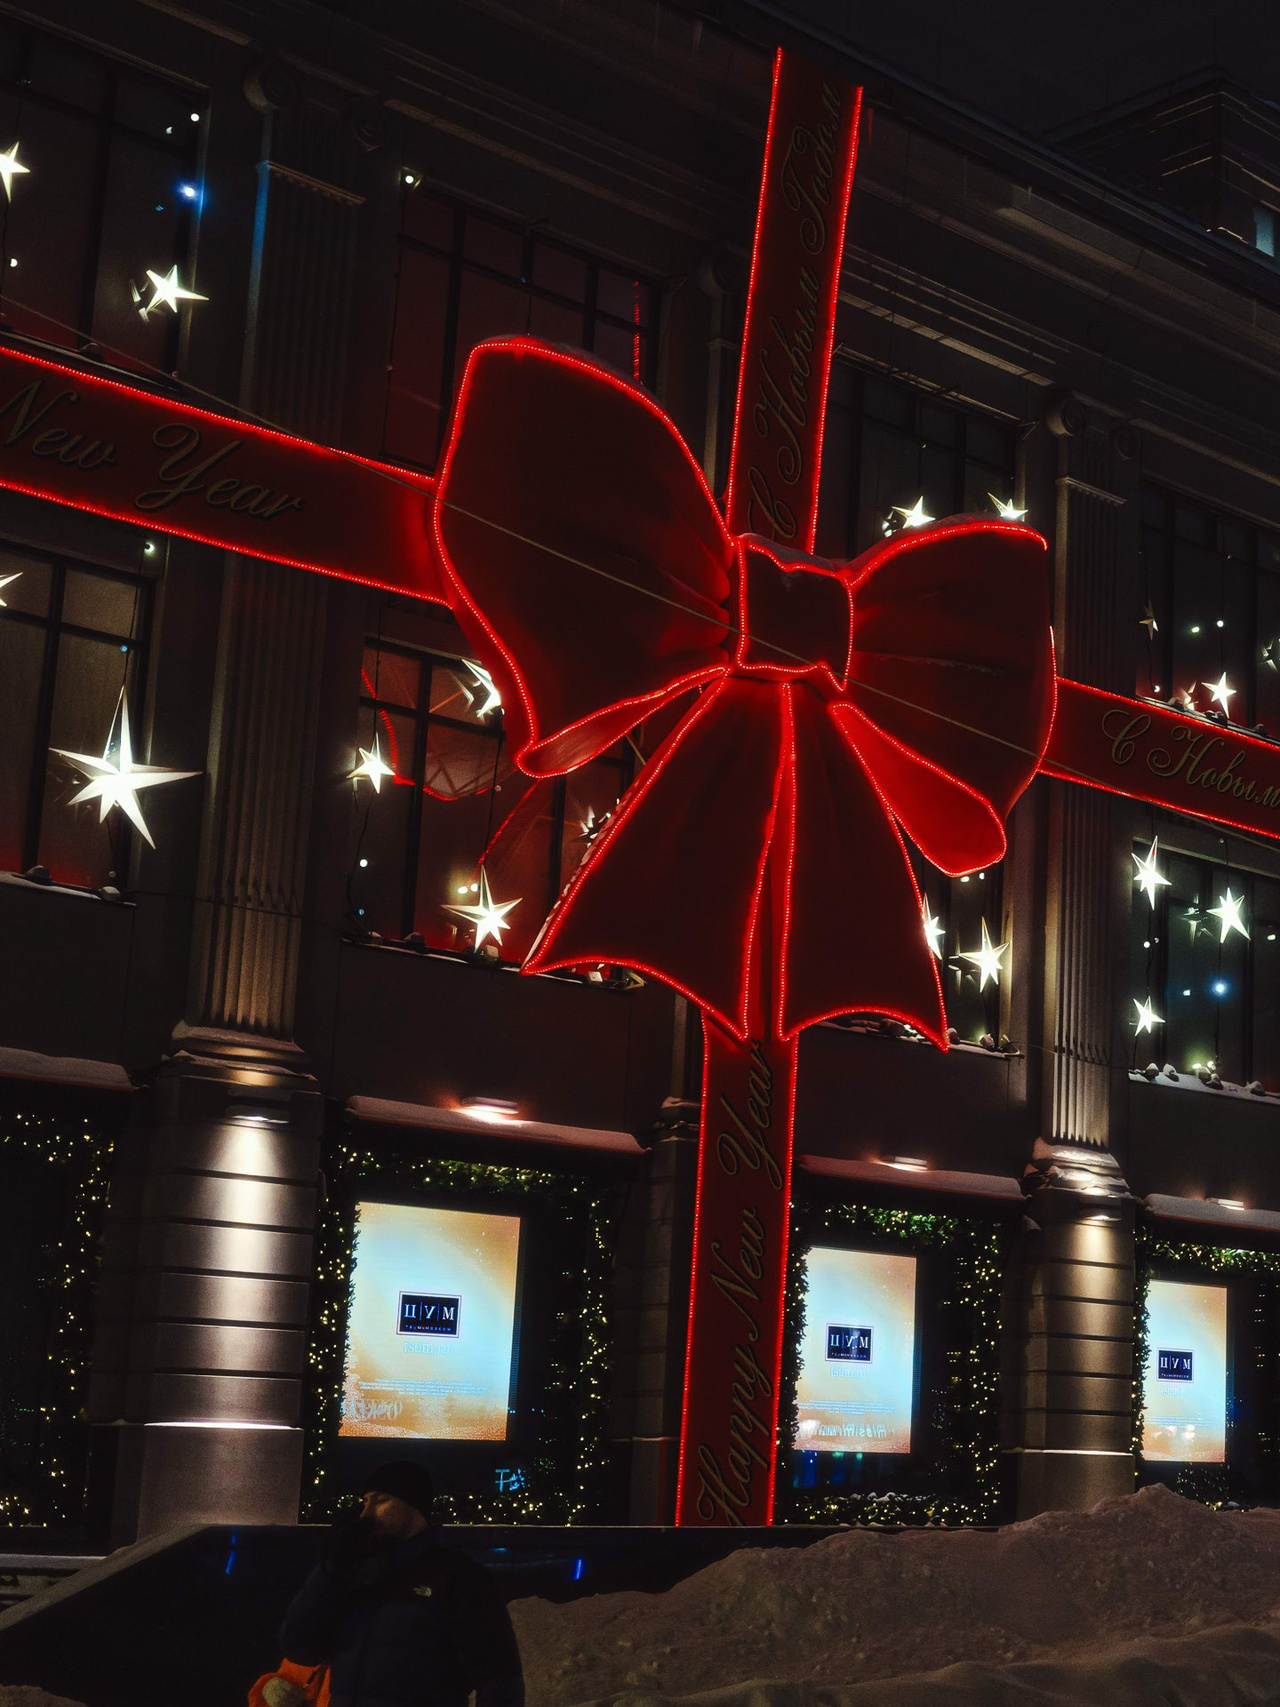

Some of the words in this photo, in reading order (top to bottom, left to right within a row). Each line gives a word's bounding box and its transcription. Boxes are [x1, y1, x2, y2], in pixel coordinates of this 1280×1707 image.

[781, 81, 841, 255] Годом
[0, 380, 116, 469] New
[135, 422, 305, 521] Year
[753, 266, 820, 485] Новым
[1102, 709, 1151, 765] С
[1147, 725, 1280, 808] Новым
[716, 1038, 782, 1190] Year
[710, 1207, 764, 1342] New
[697, 1345, 773, 1526] Happy
